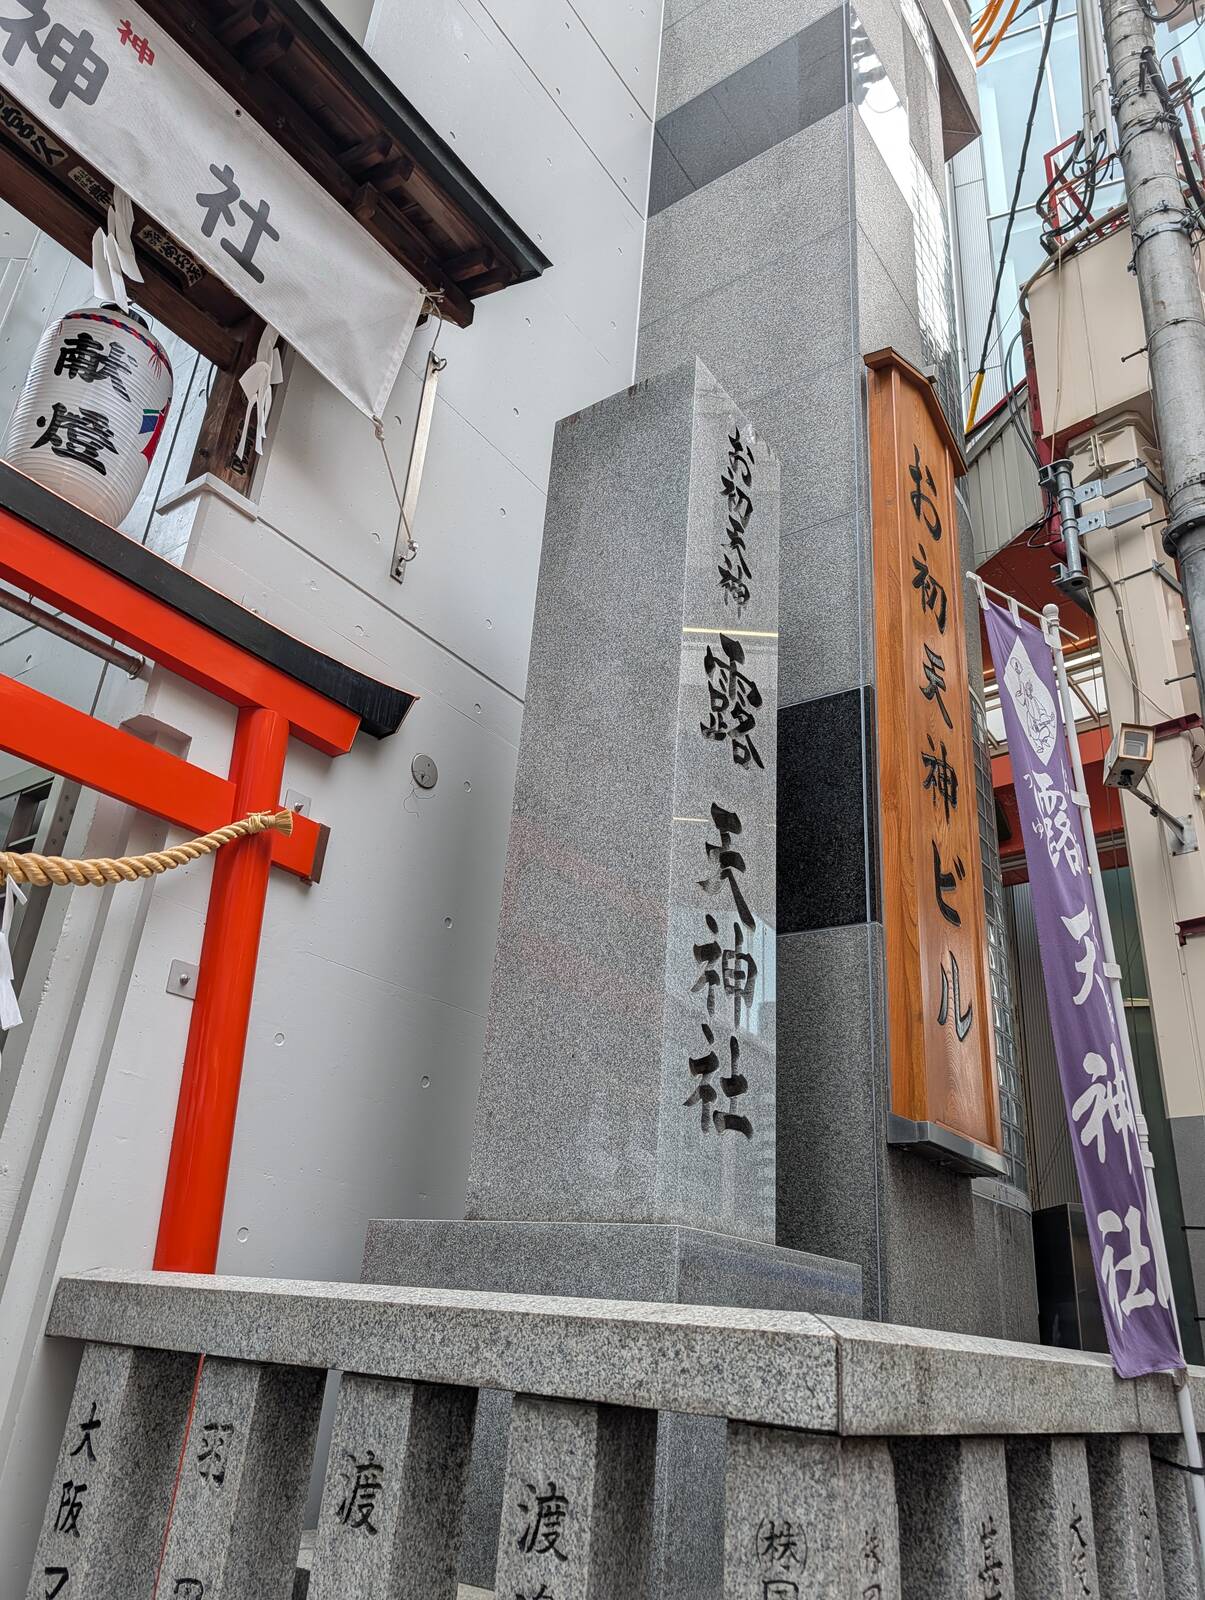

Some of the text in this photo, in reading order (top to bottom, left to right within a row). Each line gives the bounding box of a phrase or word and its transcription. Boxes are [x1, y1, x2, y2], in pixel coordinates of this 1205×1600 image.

[0, 0, 280, 283] 神社
[116, 19, 155, 66] 神
[682, 426, 765, 1140] お初天神 露天神社
[907, 443, 973, 1042] お初天神ビル
[1031, 765, 1156, 1333] 露天神社
[334, 1450, 385, 1536] 渡
